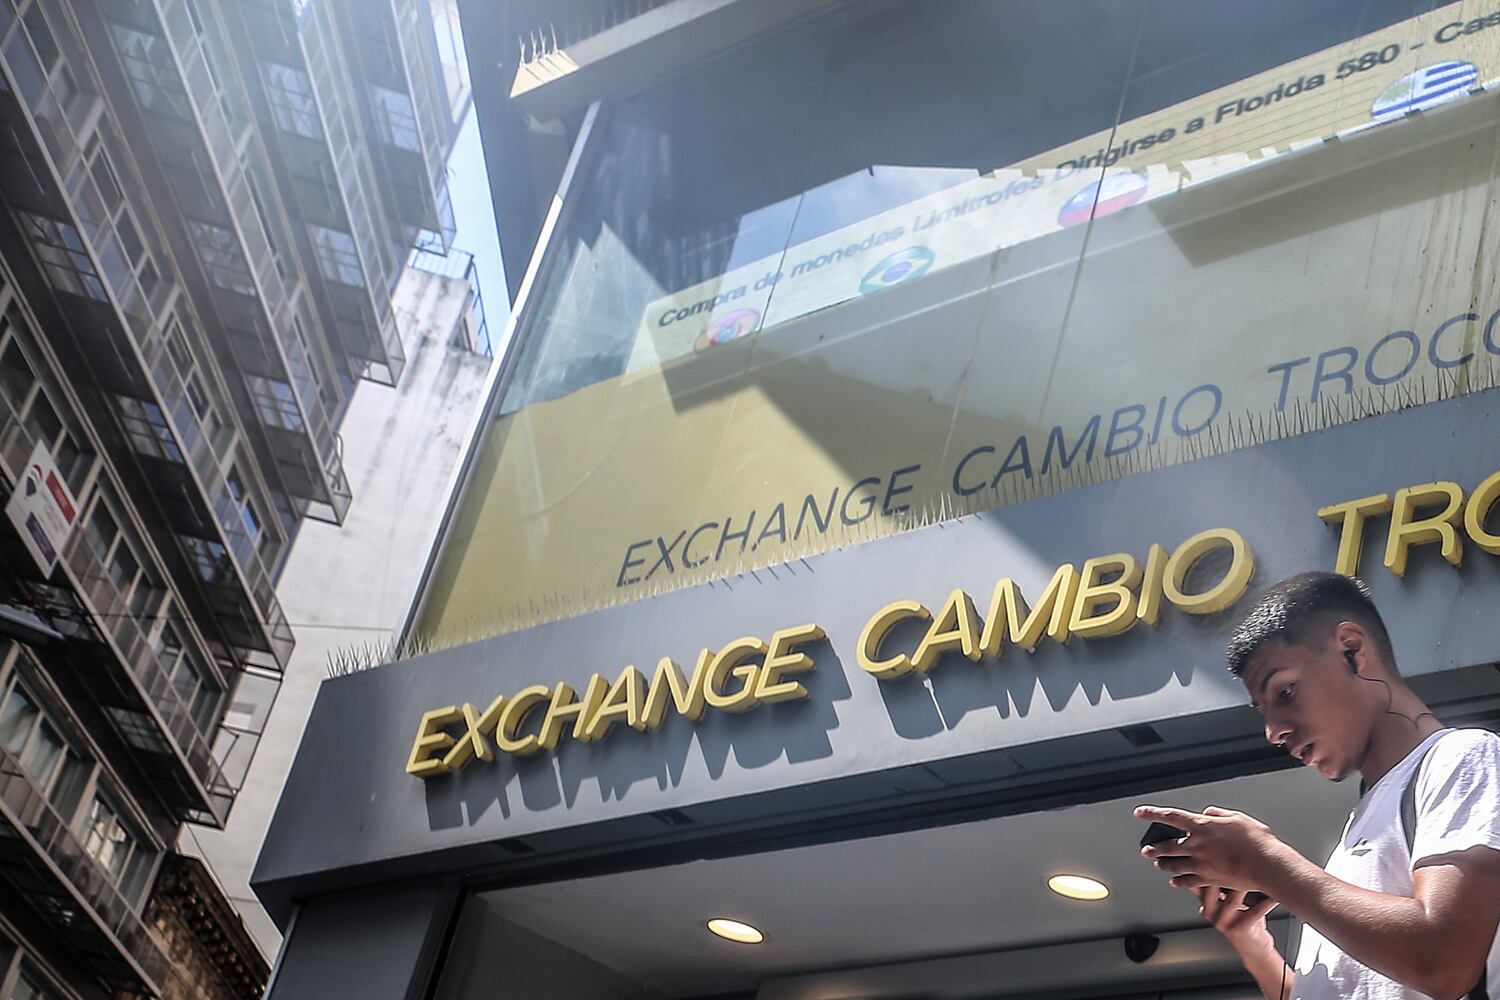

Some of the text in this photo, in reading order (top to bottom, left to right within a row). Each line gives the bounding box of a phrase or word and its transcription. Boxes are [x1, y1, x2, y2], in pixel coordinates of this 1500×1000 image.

[658, 285, 747, 327] Compra
[754, 271, 784, 292] de
[790, 225, 905, 279] monedas
[1054, 126, 1176, 181] Dirigirse
[1185, 117, 1205, 135] a
[1214, 72, 1326, 124] Florida
[1335, 43, 1400, 81] 580
[616, 464, 922, 588] EXCHANGE
[951, 383, 1223, 497] CAMBIO
[405, 623, 827, 779] EXCHANGE
[856, 527, 1255, 680] CAMBIO
